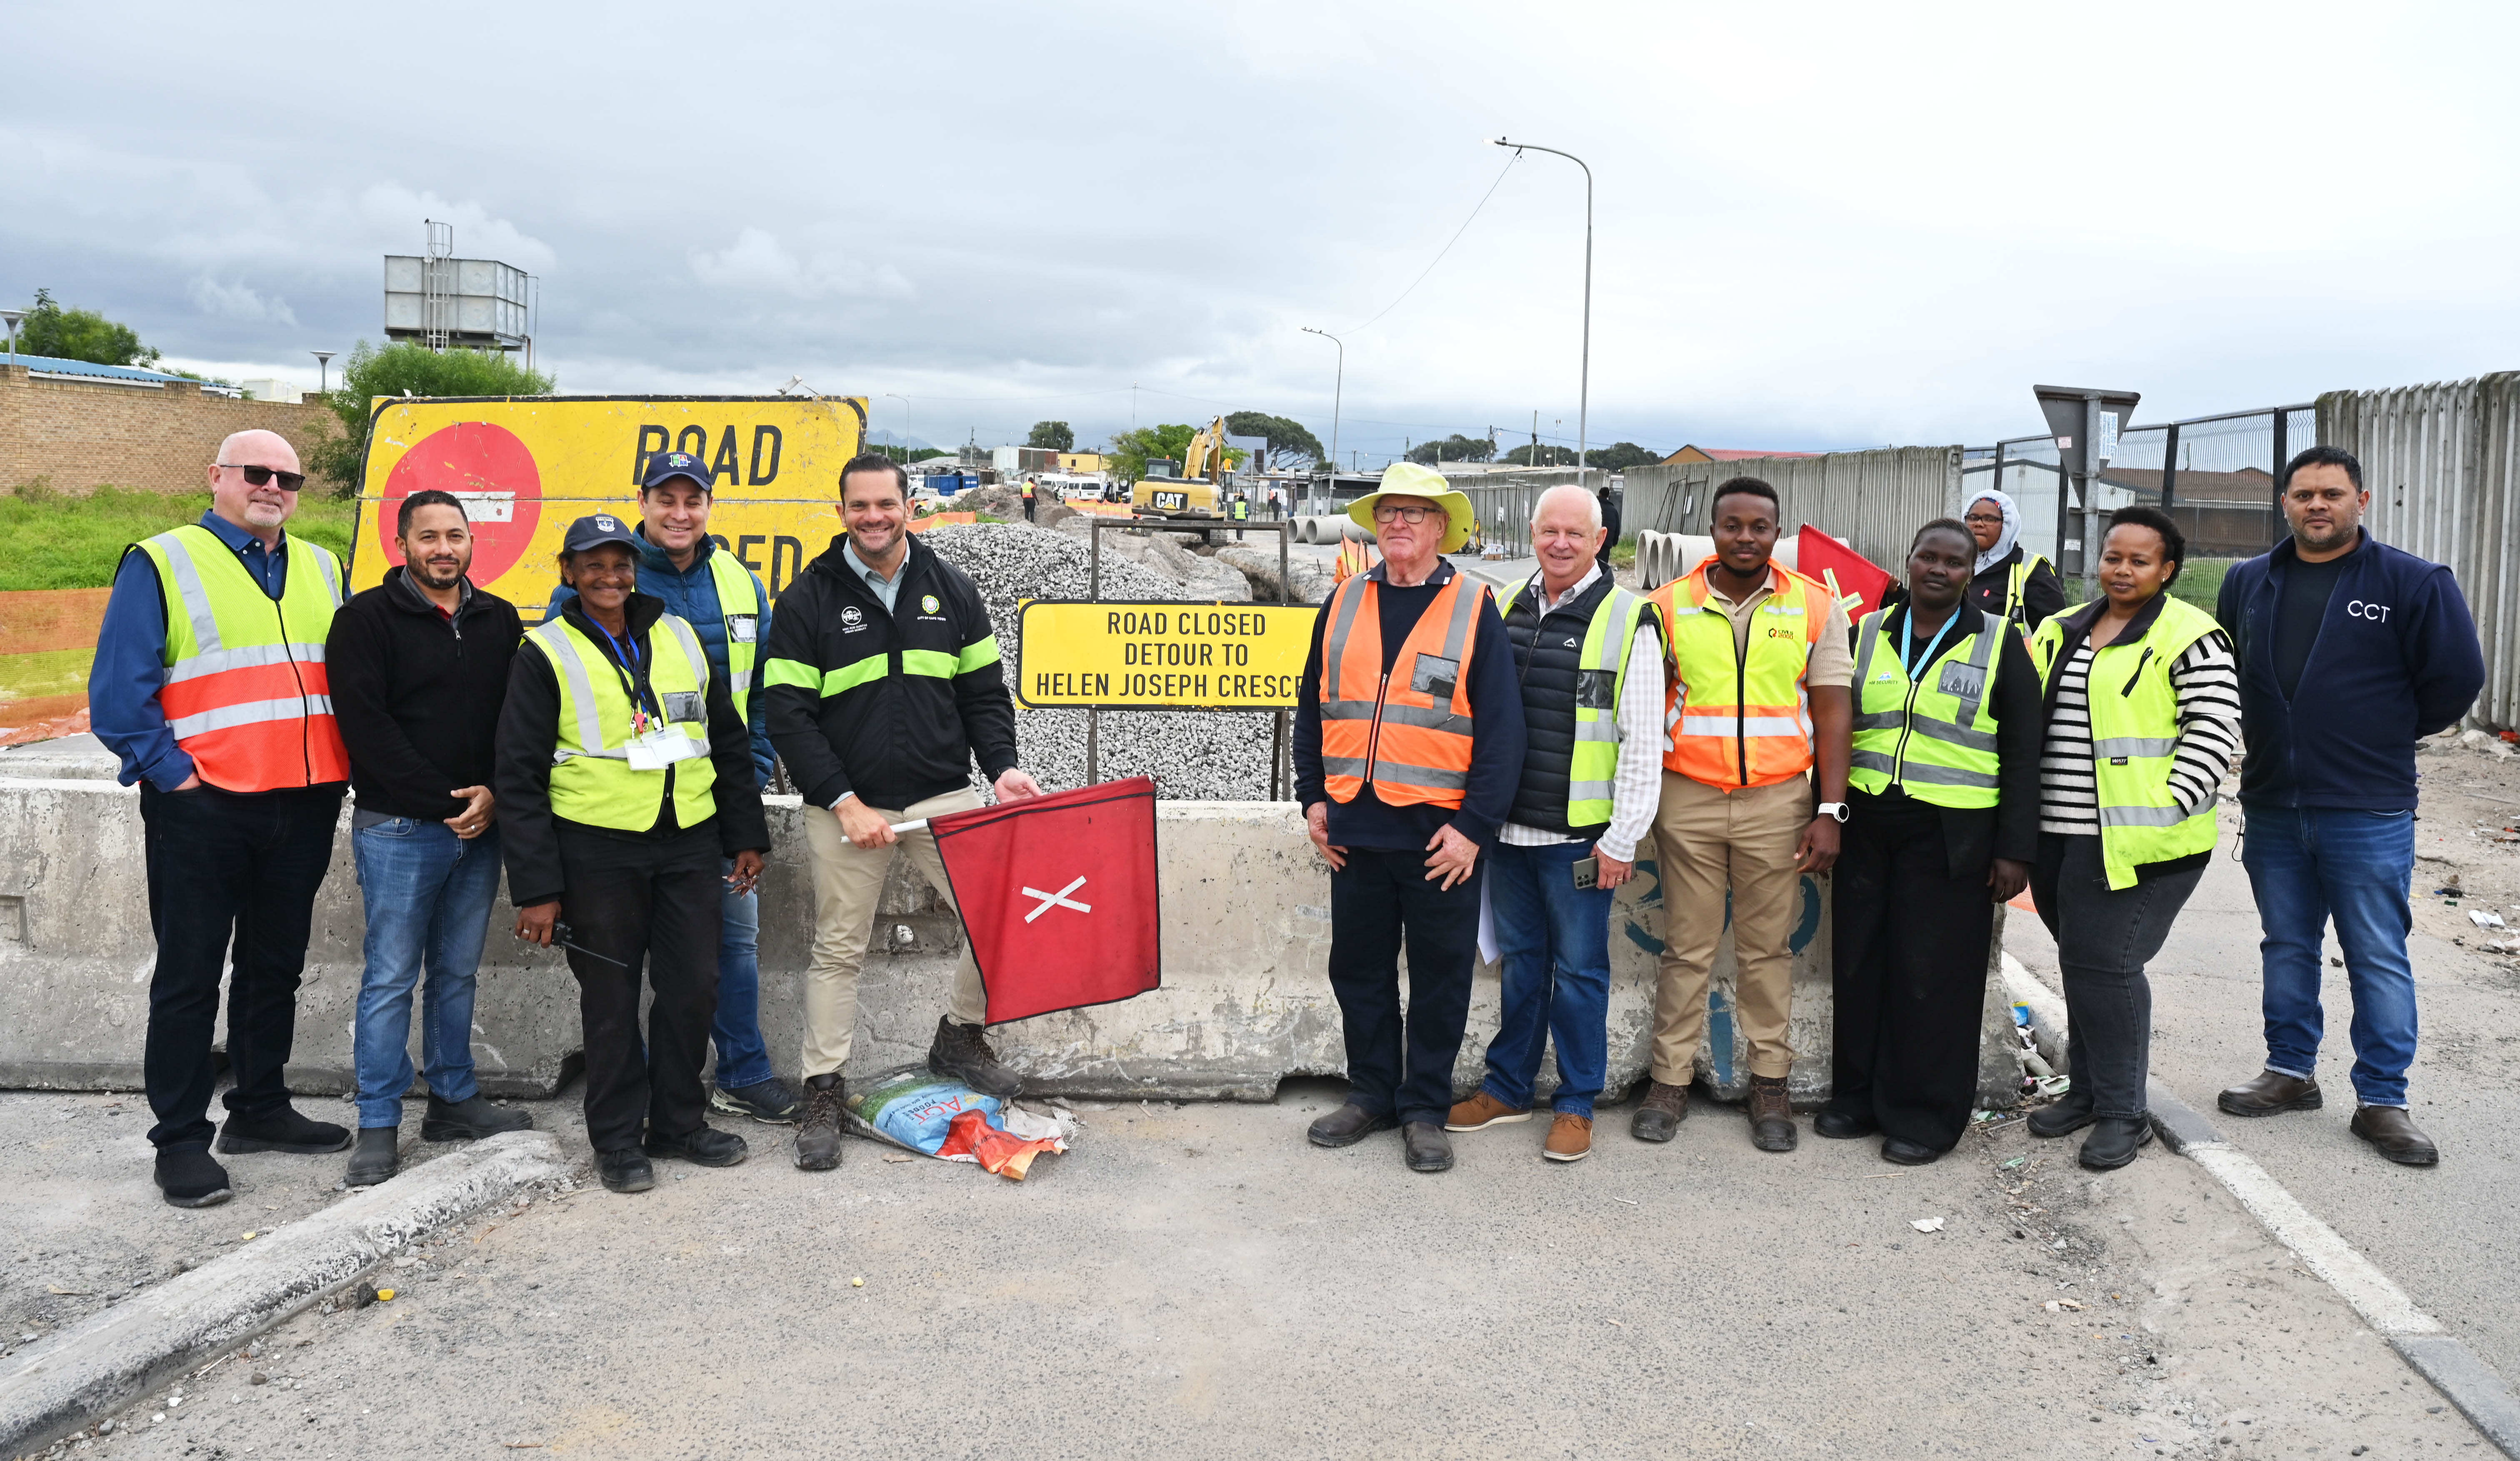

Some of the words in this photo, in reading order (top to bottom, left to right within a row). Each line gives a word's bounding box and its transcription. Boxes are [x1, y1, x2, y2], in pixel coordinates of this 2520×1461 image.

[1156, 492, 1183, 509] CAT
[2347, 600, 2390, 623] CCT
[1108, 612, 1166, 634] ROAD
[1179, 613, 1265, 635] CLOSED
[1125, 643, 1212, 665] DETOUR
[1222, 644, 1247, 666] TO
[1037, 674, 1108, 695] HELEN
[1119, 674, 1206, 697] JOSEPH
